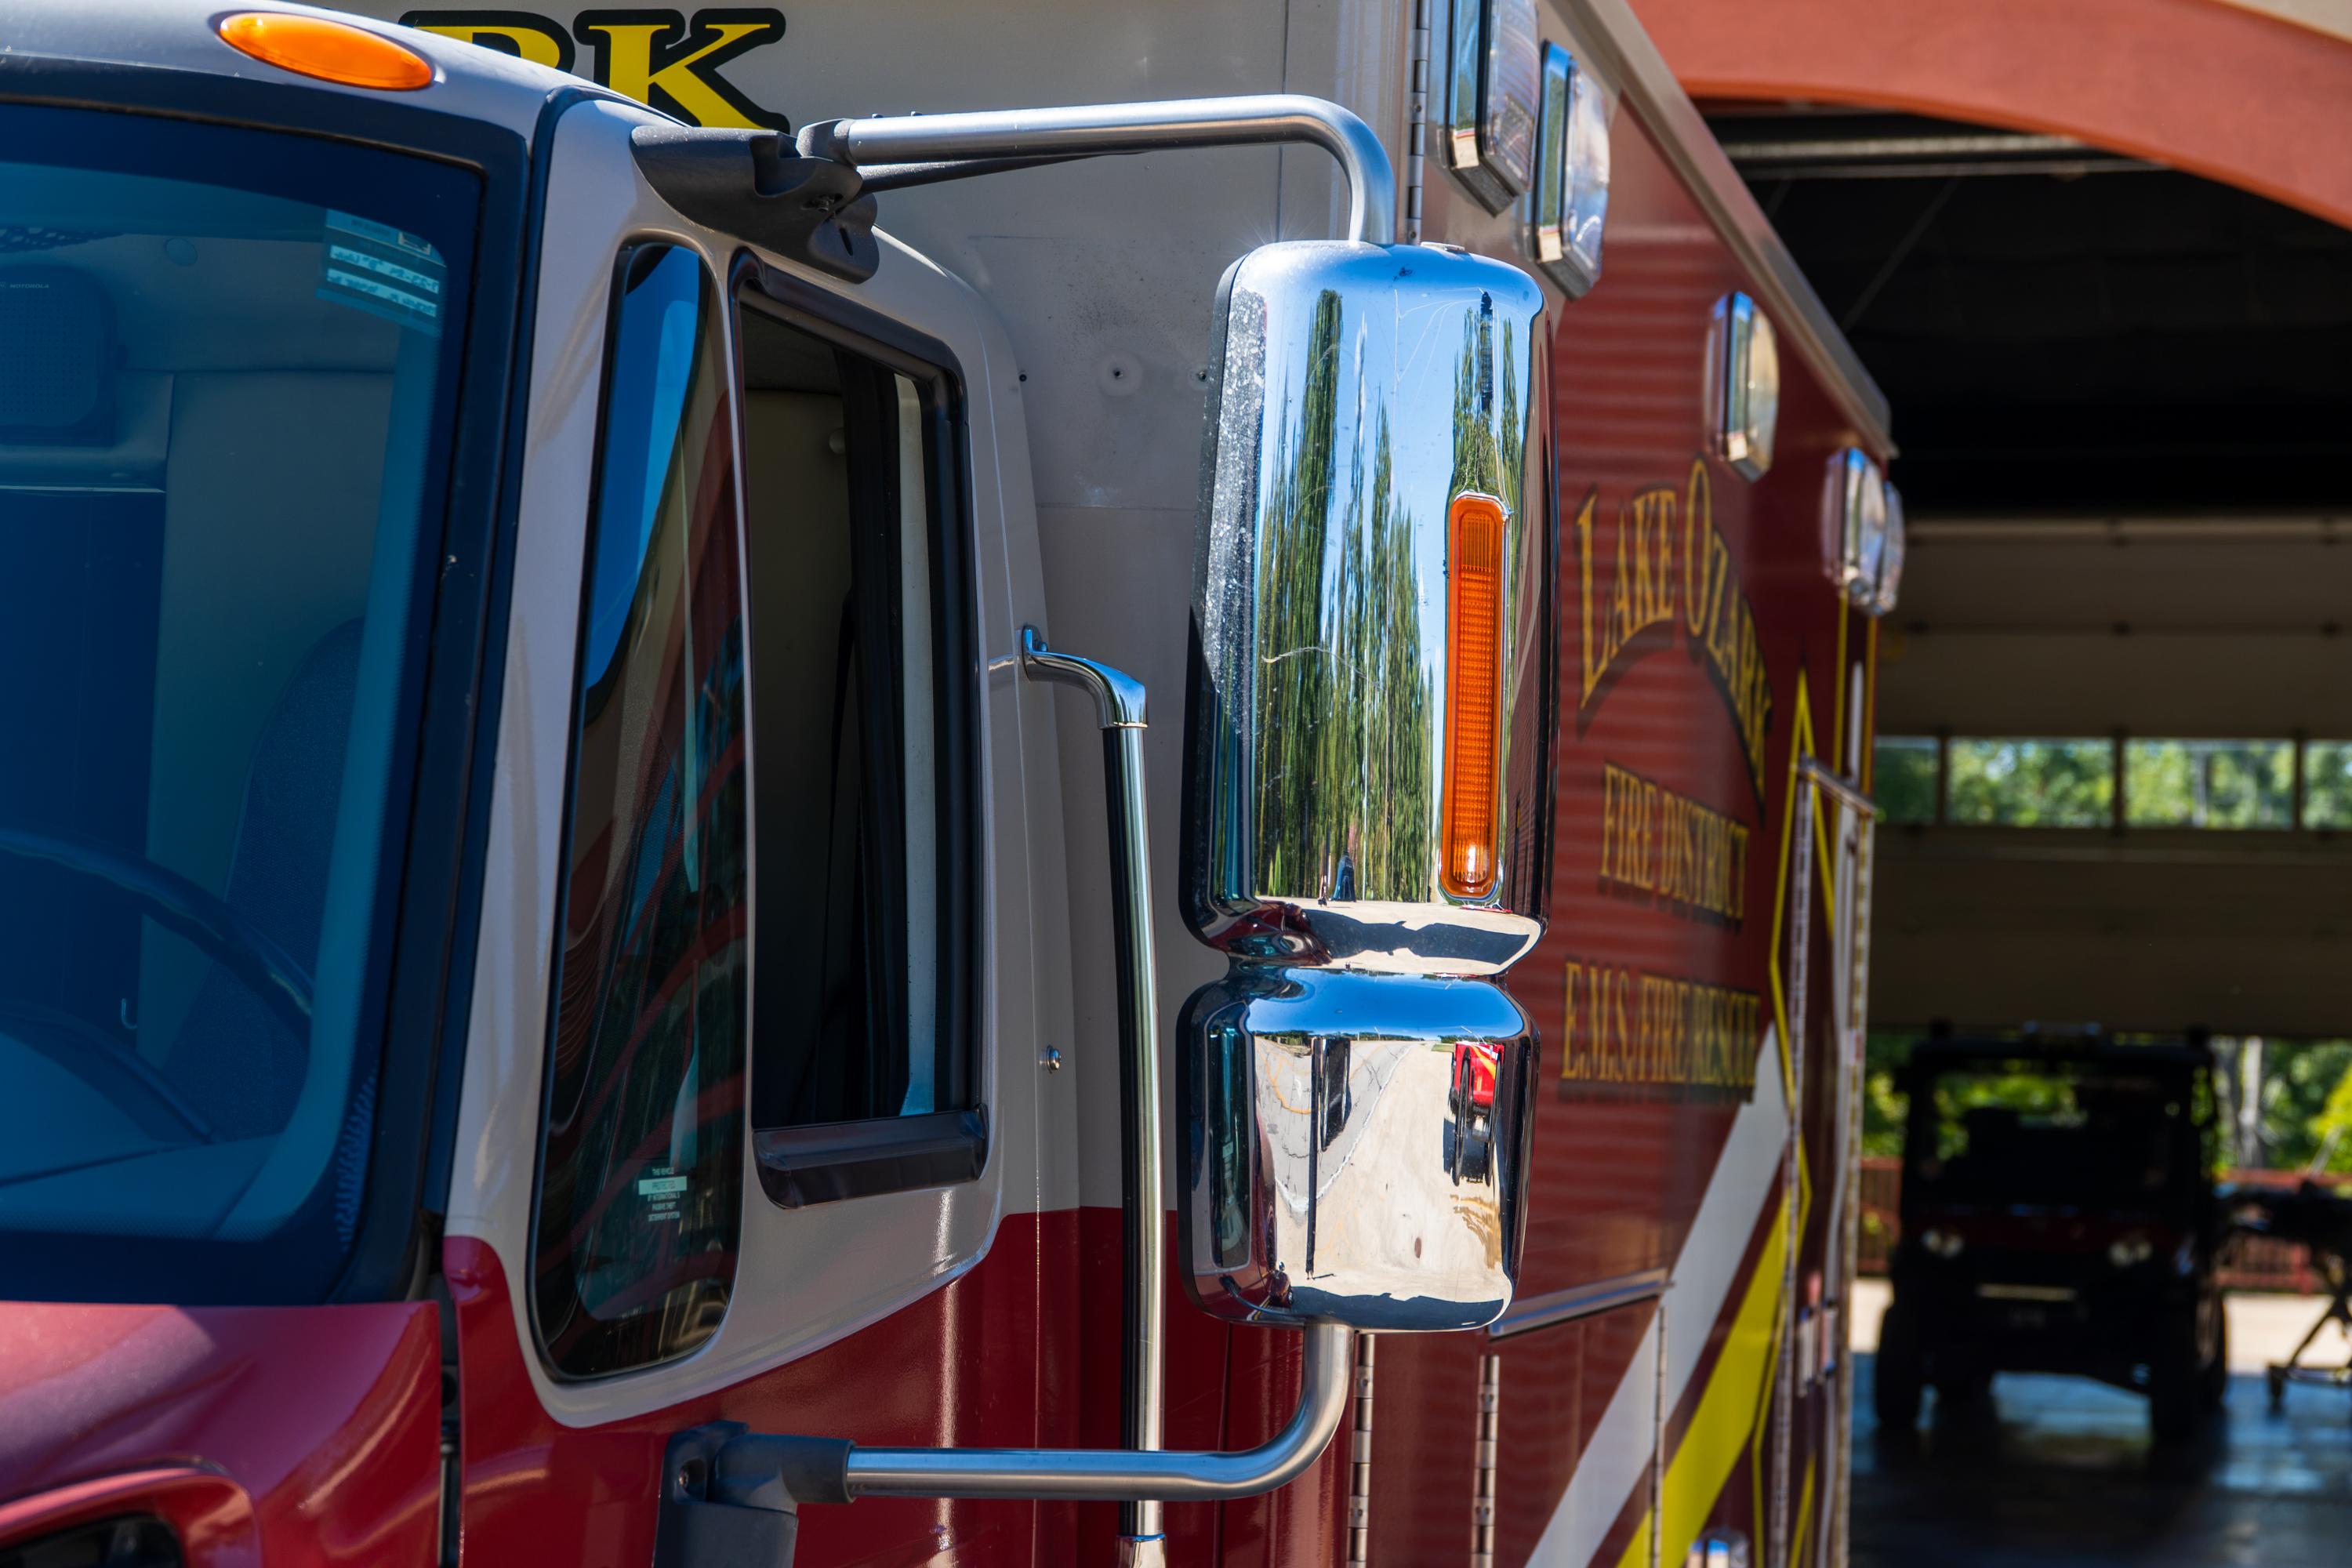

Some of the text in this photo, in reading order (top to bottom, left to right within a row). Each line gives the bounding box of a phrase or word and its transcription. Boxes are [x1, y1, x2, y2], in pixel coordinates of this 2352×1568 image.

[1576, 457, 1772, 797] LAKE OZARK
[1599, 763, 1750, 922] FIRE DISTRICT
